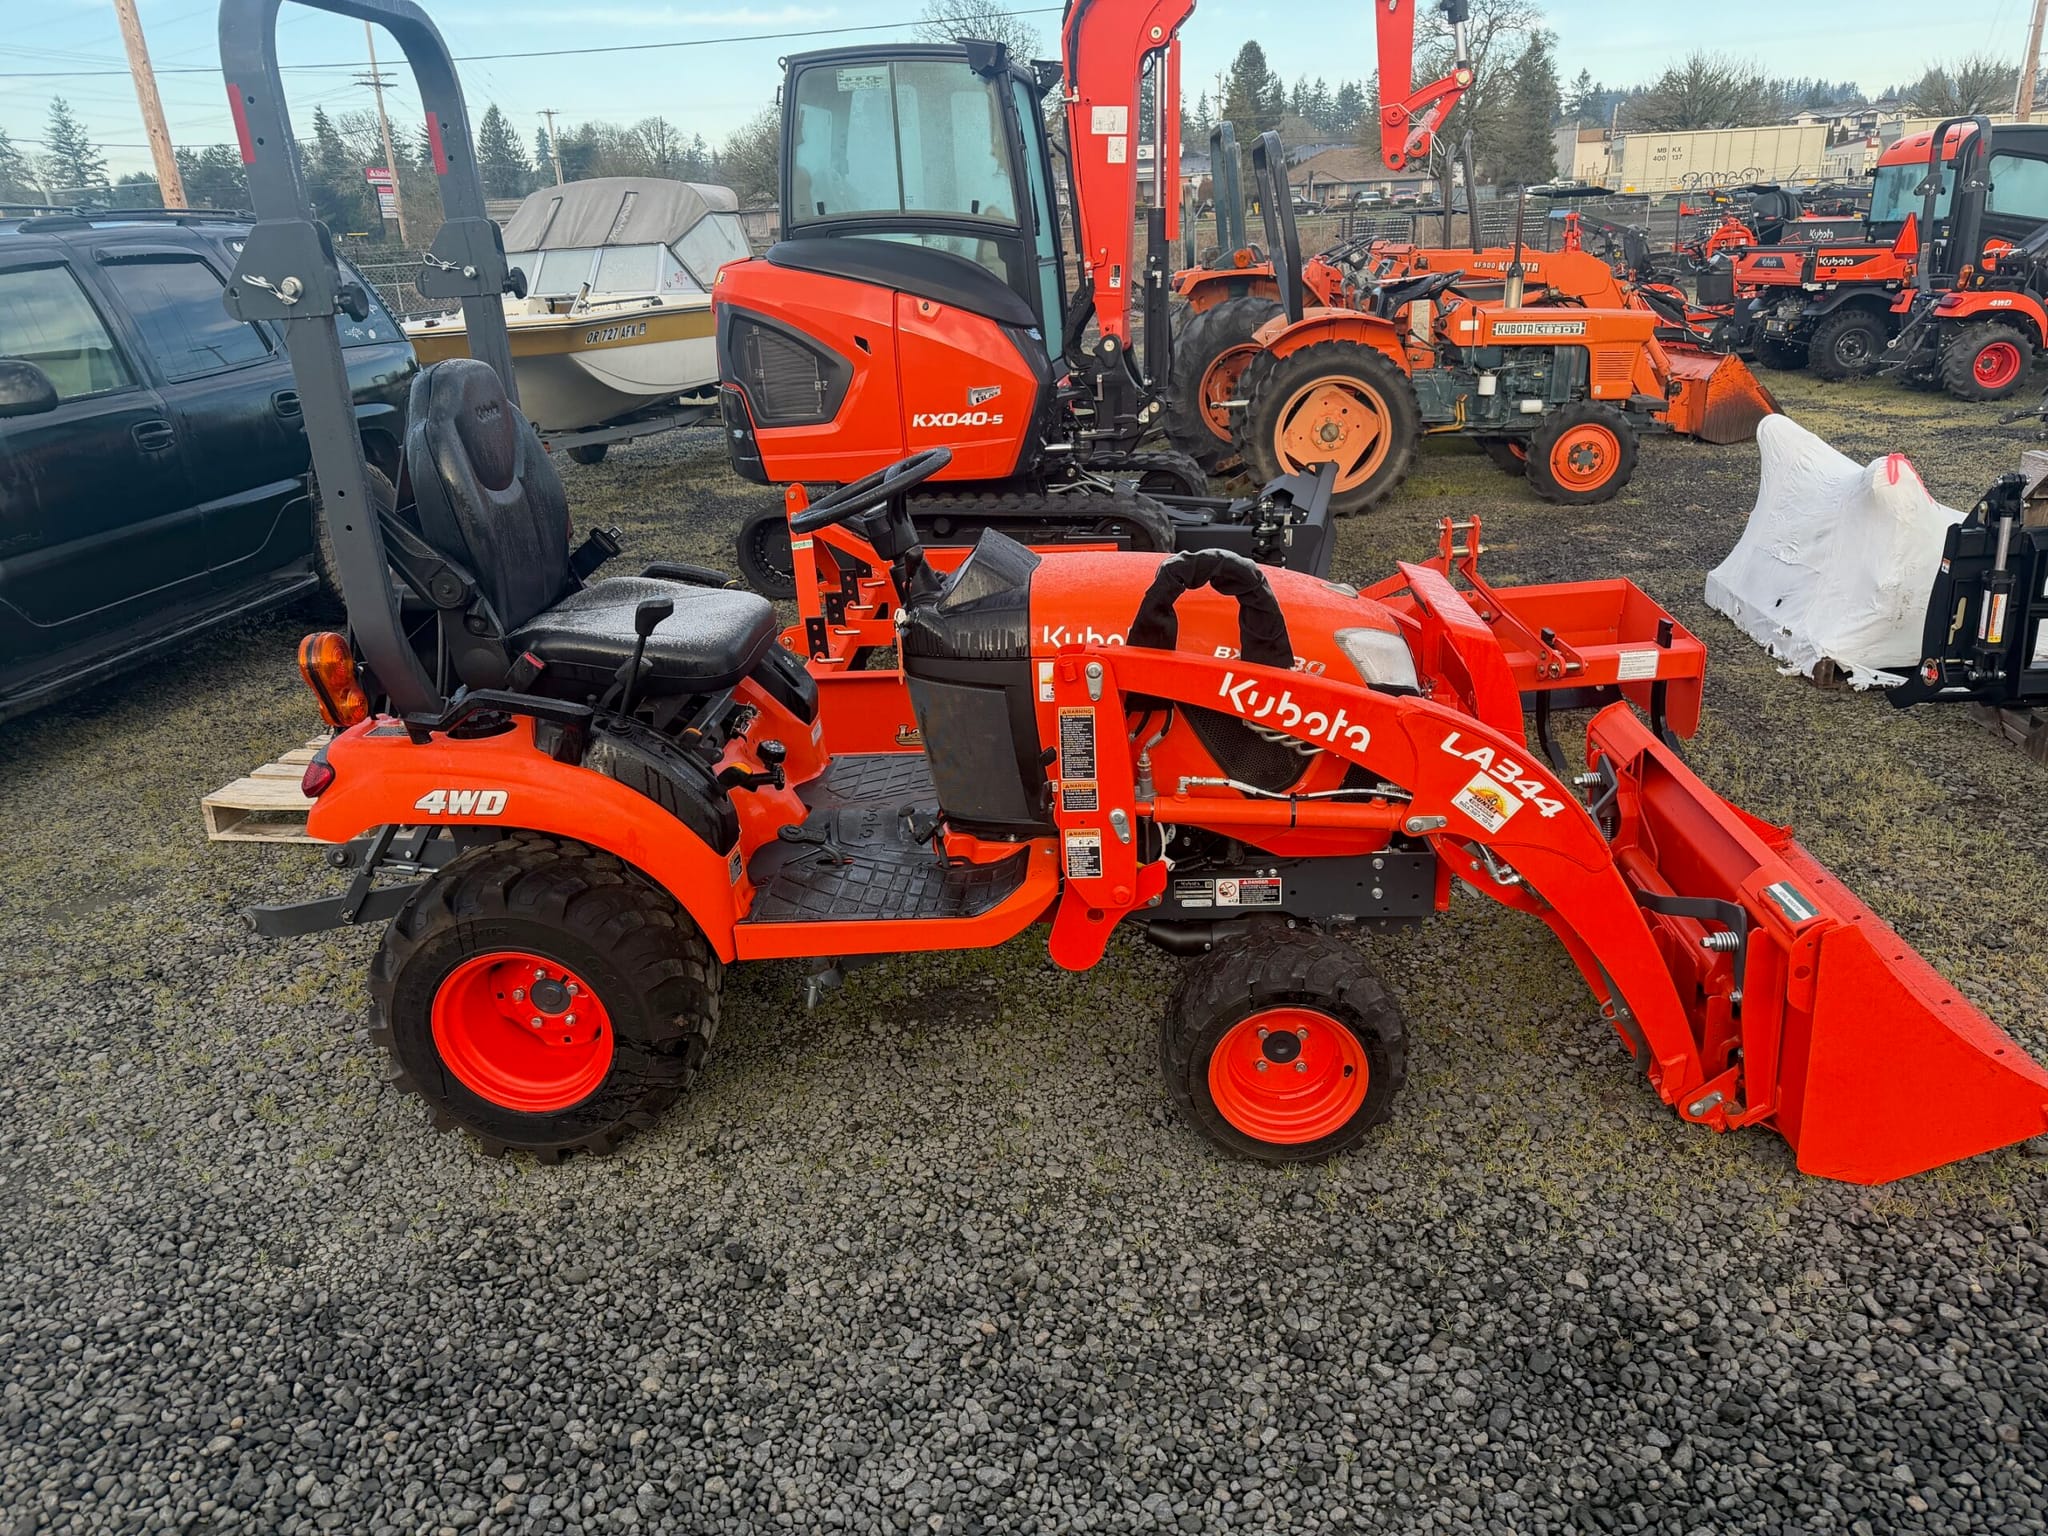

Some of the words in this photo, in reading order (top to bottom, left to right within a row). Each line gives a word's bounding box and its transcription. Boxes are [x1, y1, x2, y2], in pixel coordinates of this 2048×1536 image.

[1809, 228, 1834, 240] Kubota
[1498, 261, 1539, 273] KUOTA
[1819, 257, 1854, 266] Kubota
[1989, 299, 2013, 307] 4WD
[586, 331, 600, 344] OR
[601, 327, 619, 341] 727
[620, 324, 637, 338] AFK
[1497, 323, 1533, 334] KUBOTA
[1217, 671, 1371, 753] Kubota
[1440, 731, 1566, 818] LA344
[414, 789, 509, 816] 4WD
